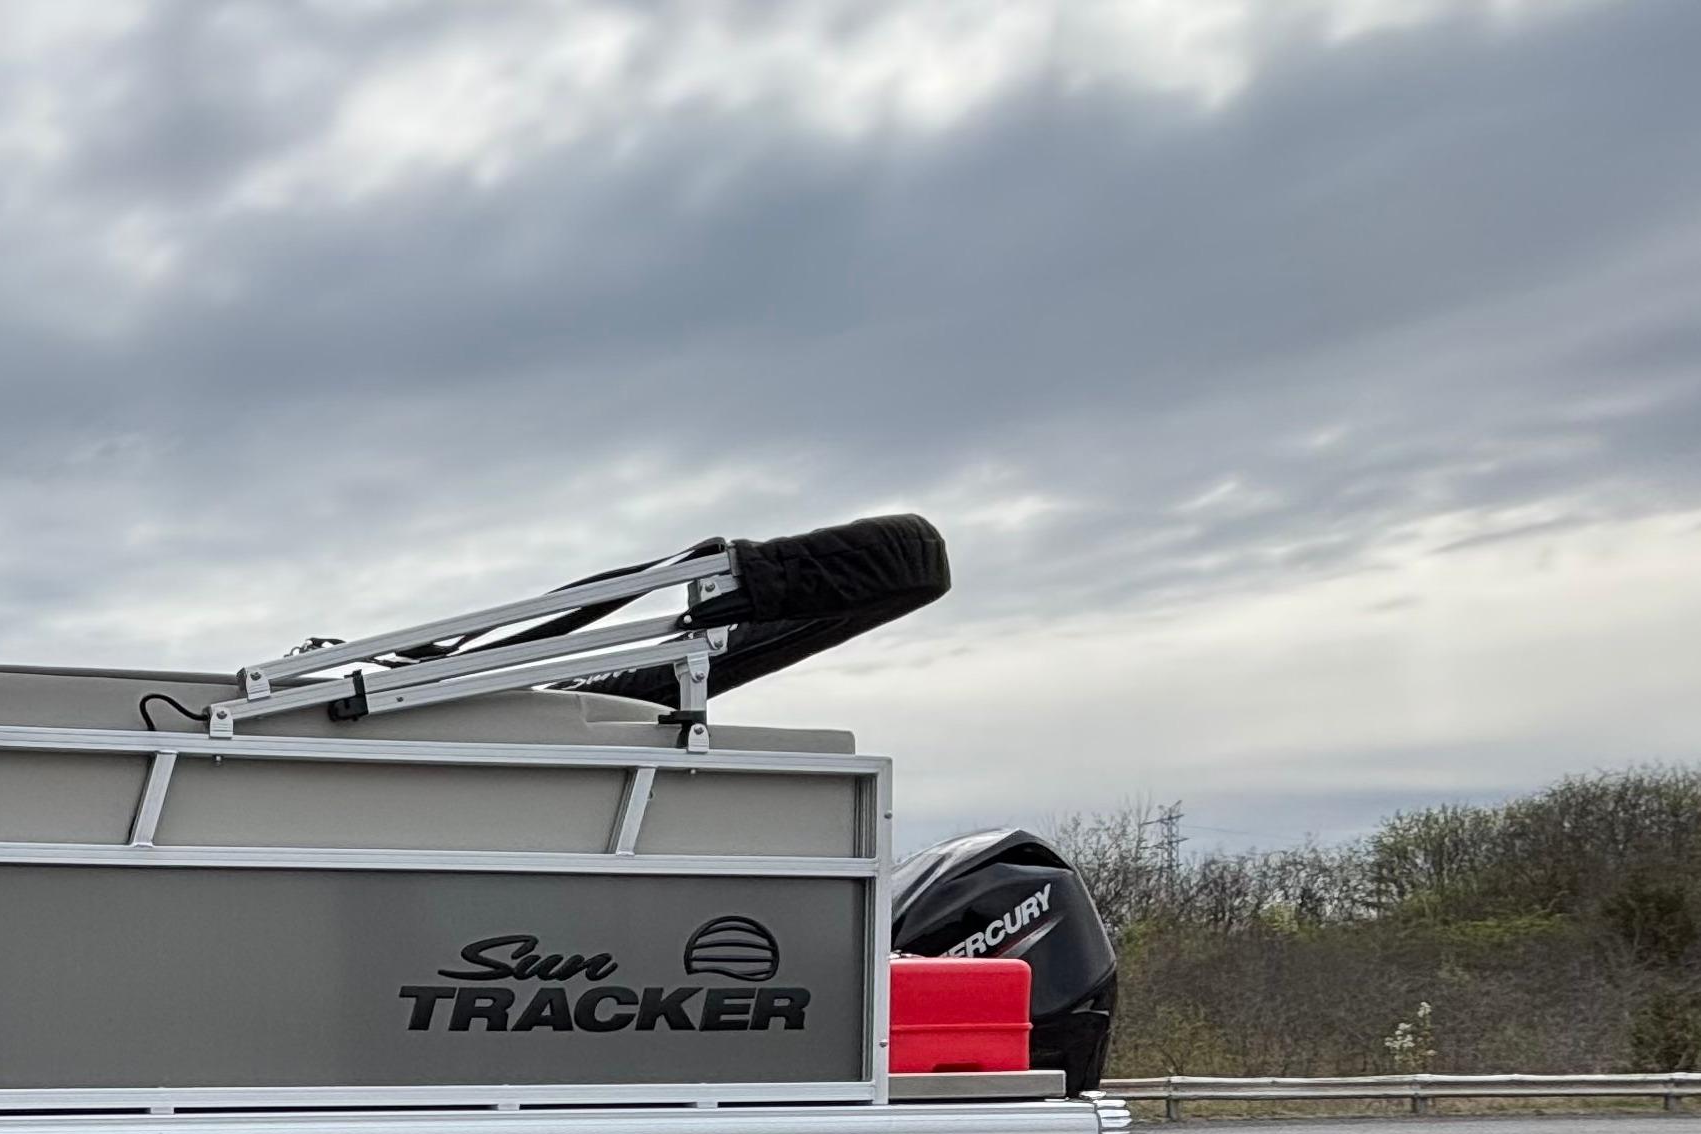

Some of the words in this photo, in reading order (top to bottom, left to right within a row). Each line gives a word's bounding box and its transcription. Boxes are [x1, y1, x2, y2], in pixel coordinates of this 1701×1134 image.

[940, 883, 1051, 958] ERCURY
[437, 934, 618, 981] Sun
[398, 985, 812, 1033] TRACKER
